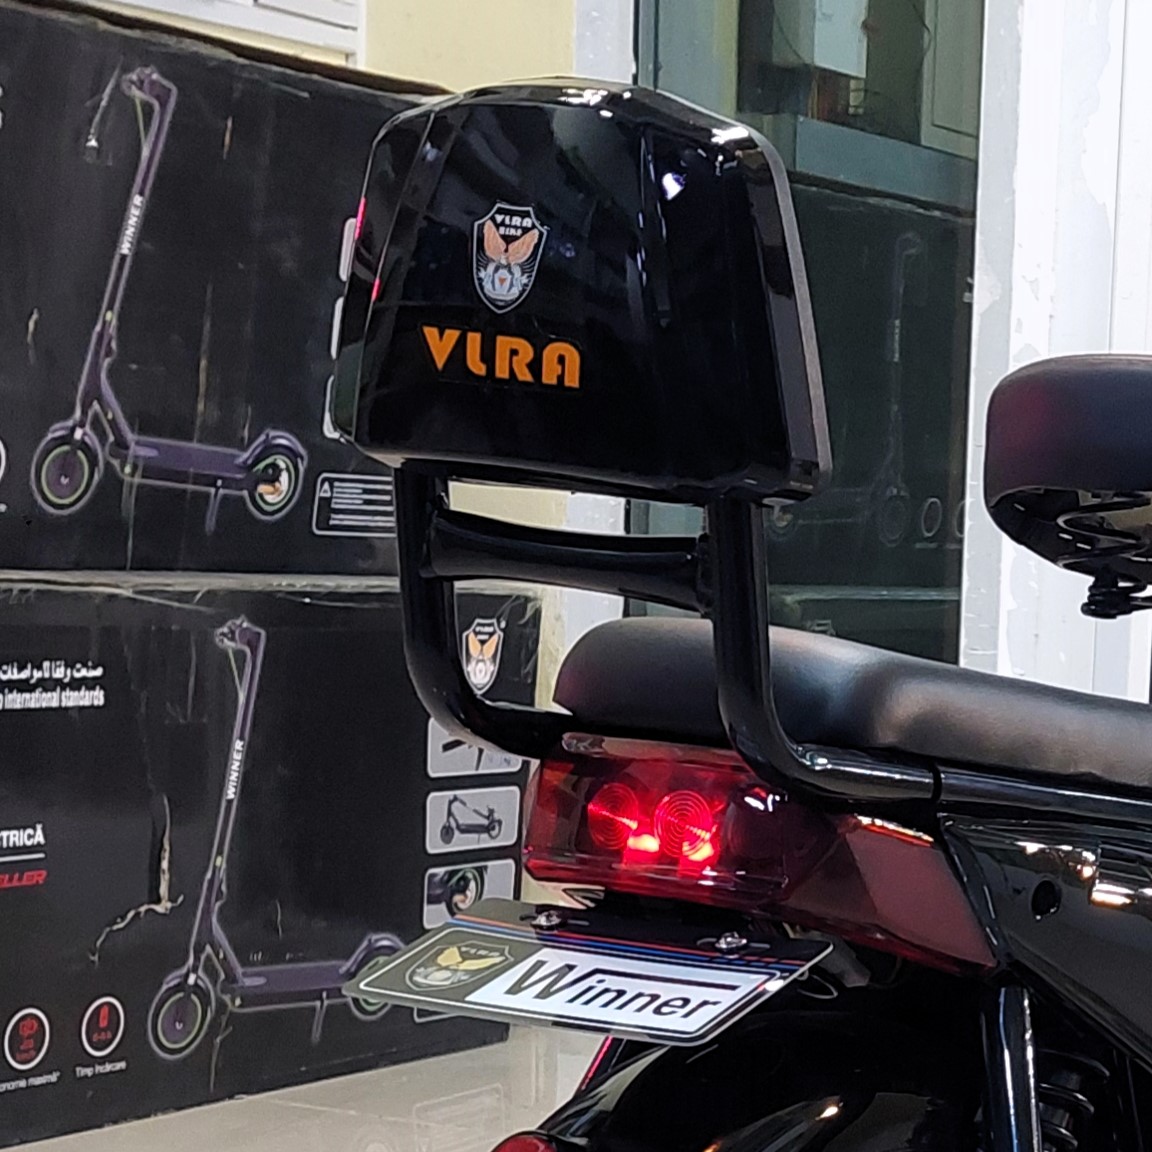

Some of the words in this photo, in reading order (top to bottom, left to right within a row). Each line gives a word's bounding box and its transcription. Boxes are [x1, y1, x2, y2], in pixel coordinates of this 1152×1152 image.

[120, 194, 143, 254] WINNER
[494, 214, 533, 227] VLRA
[422, 325, 581, 388] VLRA
[4, 687, 60, 710] international
[61, 685, 105, 708] standards
[225, 738, 244, 799] WINNER
[0, 823, 46, 849] TRICĂ
[504, 959, 722, 1018] Winner
